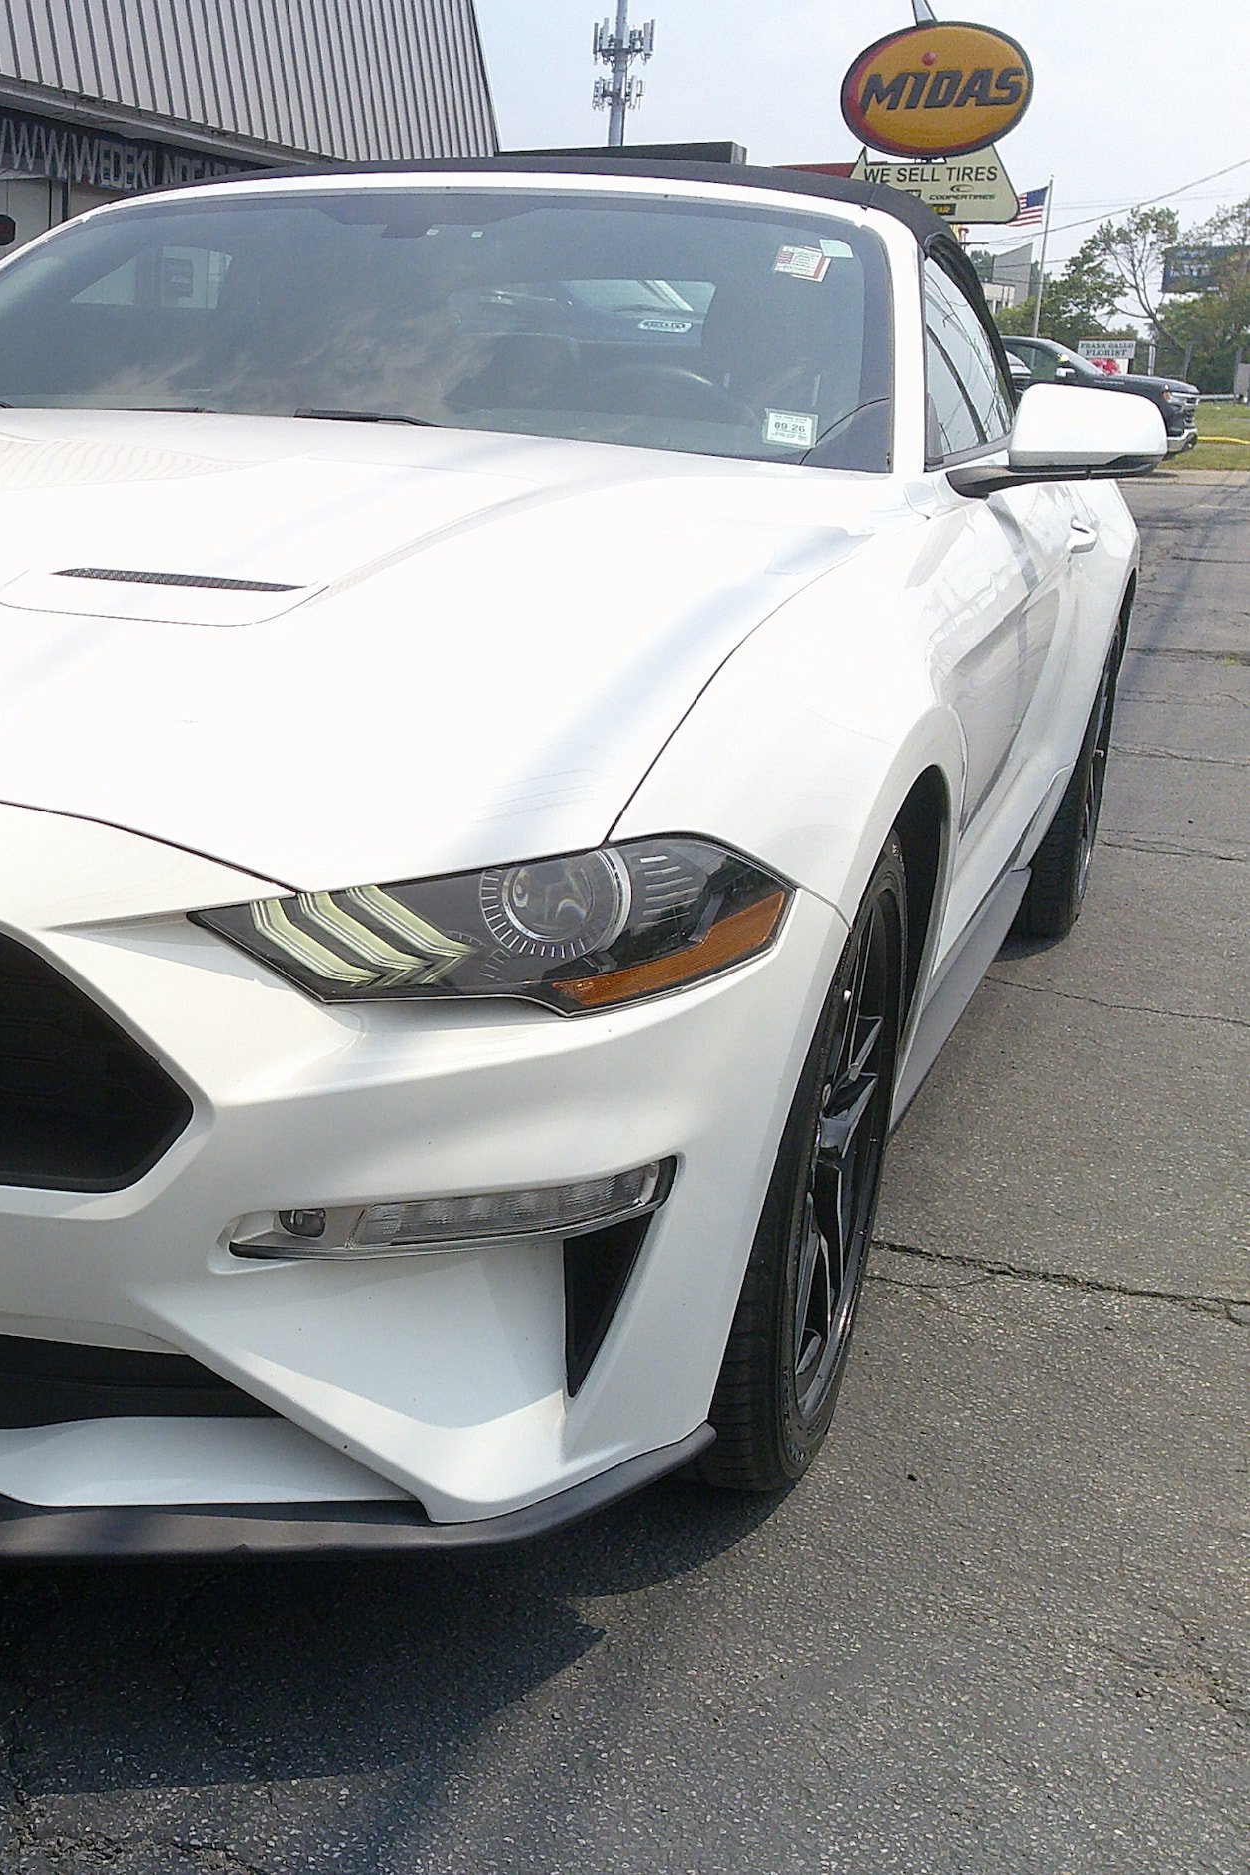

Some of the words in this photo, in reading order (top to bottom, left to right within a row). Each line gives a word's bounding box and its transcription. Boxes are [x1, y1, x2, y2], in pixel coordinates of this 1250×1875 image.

[860, 67, 1023, 116] MIDAS
[864, 167, 891, 183] WE
[897, 167, 940, 182] SELL
[946, 166, 997, 182] TIRES
